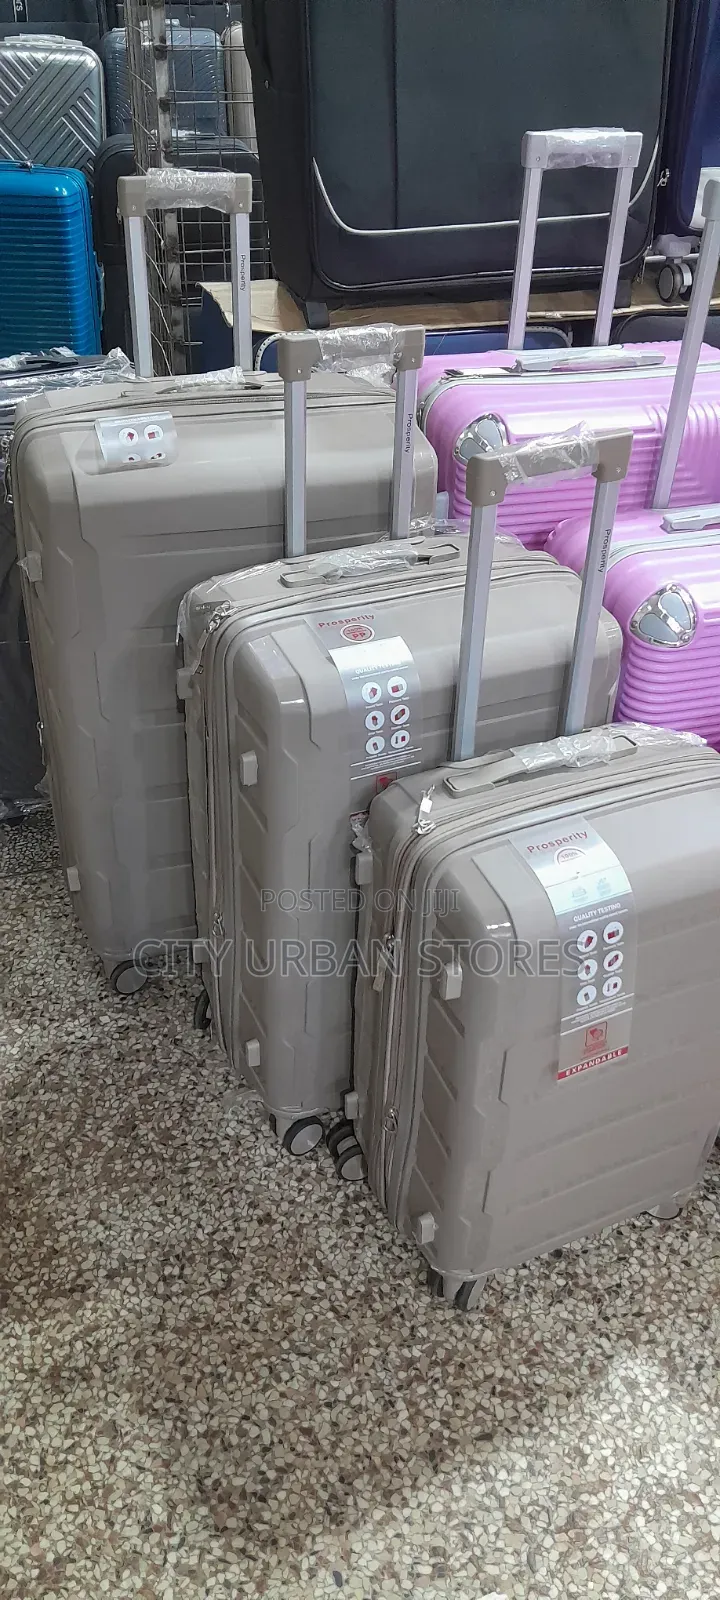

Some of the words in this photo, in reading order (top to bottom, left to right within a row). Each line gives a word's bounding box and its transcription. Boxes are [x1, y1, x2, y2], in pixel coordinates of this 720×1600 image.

[404, 413, 414, 453] Prosperity
[597, 528, 612, 573] Prosperity
[317, 614, 375, 628] Prosperity
[526, 830, 589, 854] Prosperity
[573, 909, 598, 922] QUALITY
[565, 1049, 622, 1077] EXPANDABLE
